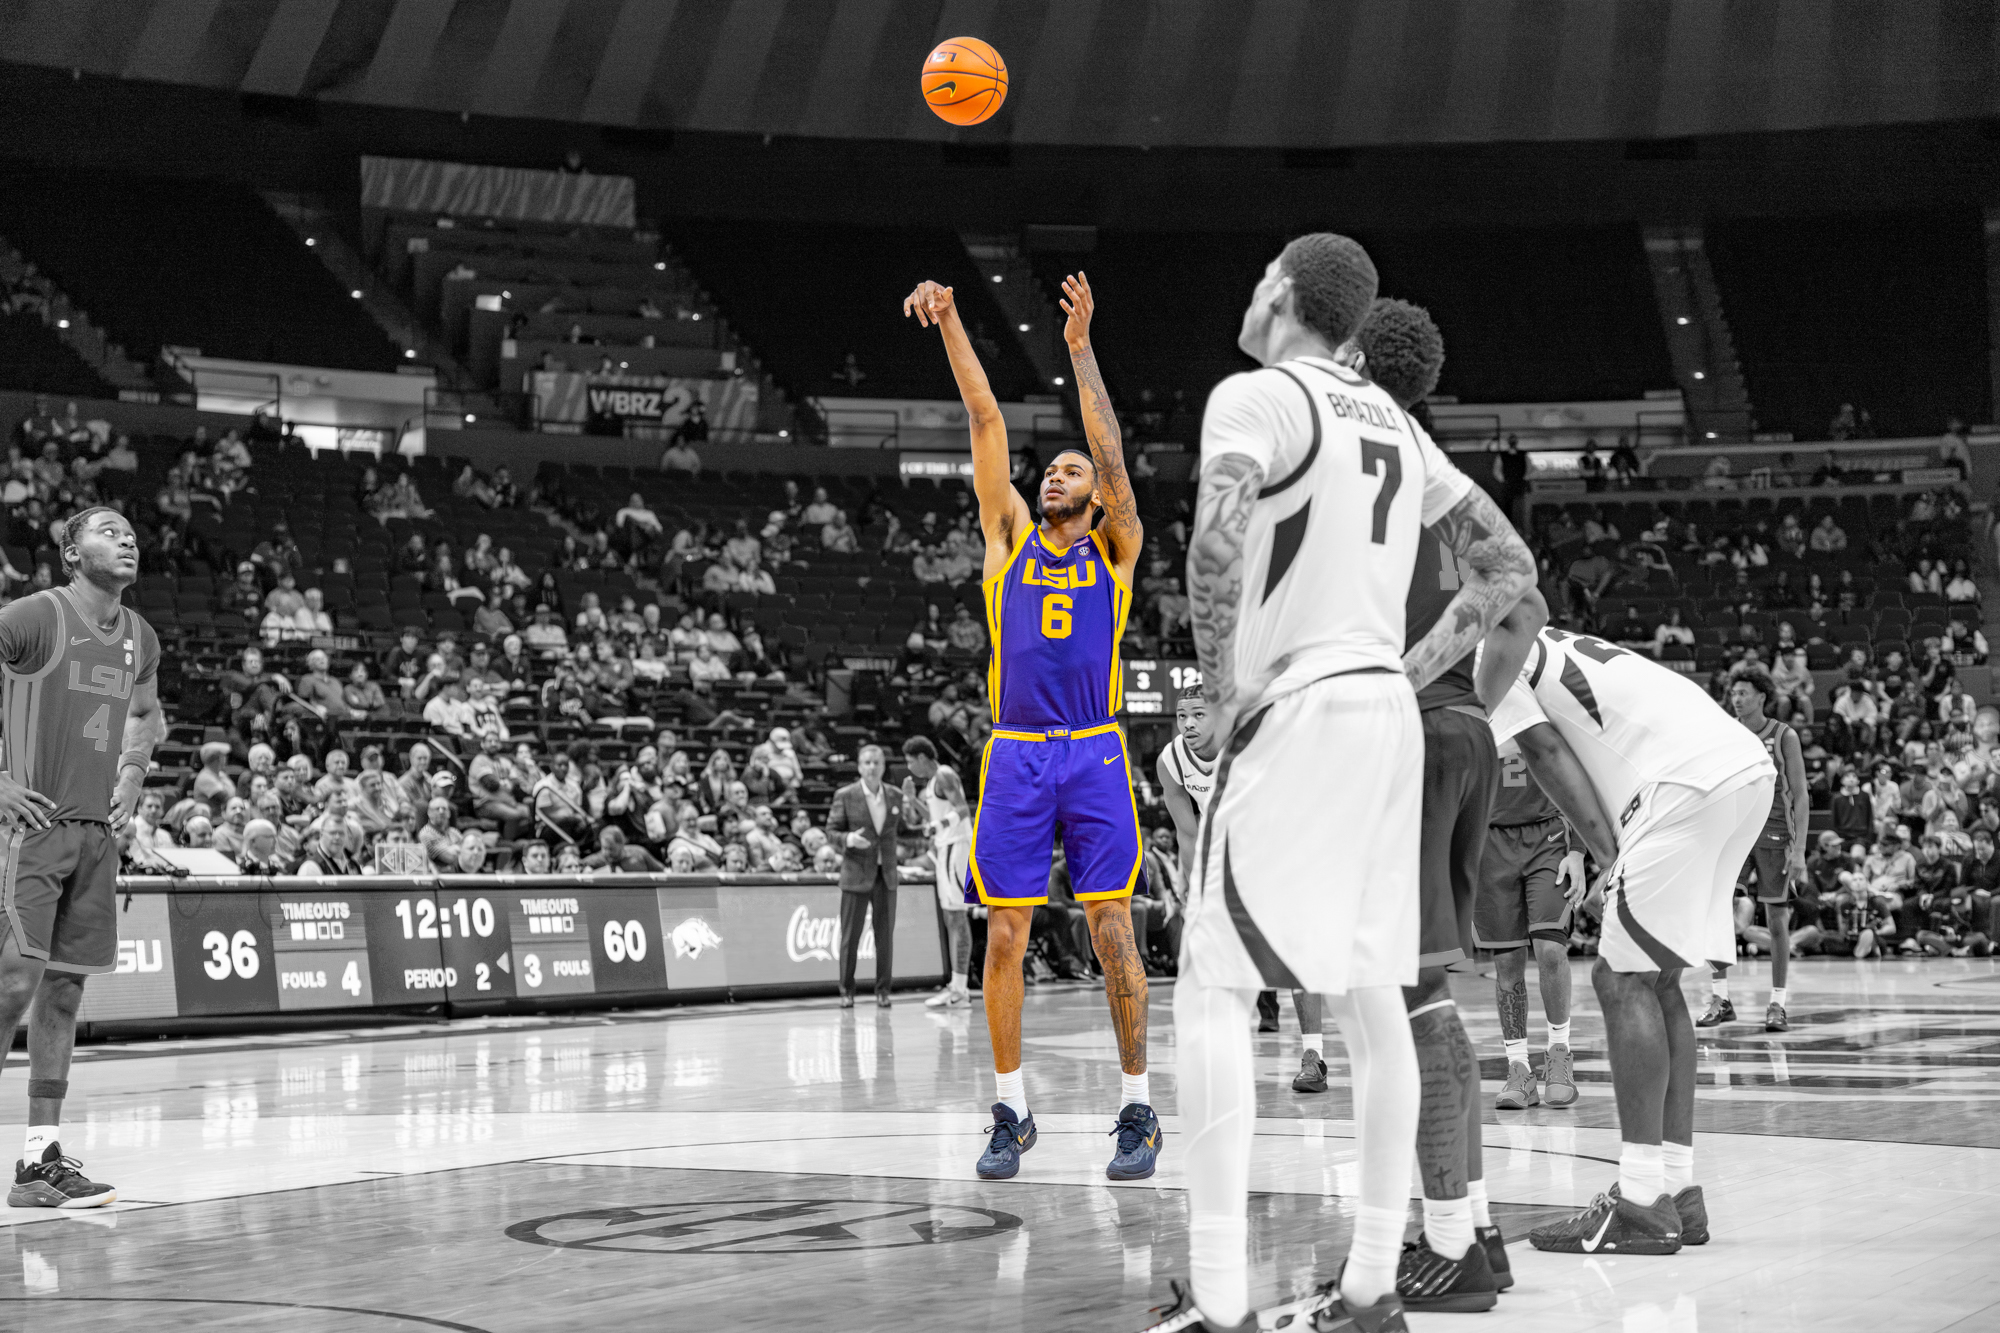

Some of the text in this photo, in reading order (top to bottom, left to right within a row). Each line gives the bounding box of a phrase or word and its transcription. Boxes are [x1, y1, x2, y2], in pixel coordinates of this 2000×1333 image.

[590, 385, 693, 426] WBRZ 2
[1360, 437, 1402, 545] 7
[1022, 558, 1096, 590] LSU
[1439, 540, 1472, 591] 1
[1041, 594, 1073, 639] 6
[68, 661, 134, 699] LSU
[1136, 672, 1151, 690] 3
[83, 704, 110, 752] 4
[1047, 729, 1069, 738] LSU
[1503, 753, 1527, 788] 2
[280, 902, 351, 920] TIMEOUTS
[395, 897, 495, 939] 12:10
[520, 898, 579, 915] TIMEOUTS
[115, 939, 163, 973] SU
[202, 929, 260, 981] 36
[603, 919, 647, 963] 60
[281, 960, 362, 997] FOULS 4
[404, 962, 491, 991] PERIOD 2
[523, 953, 591, 988] 3 FOULS
